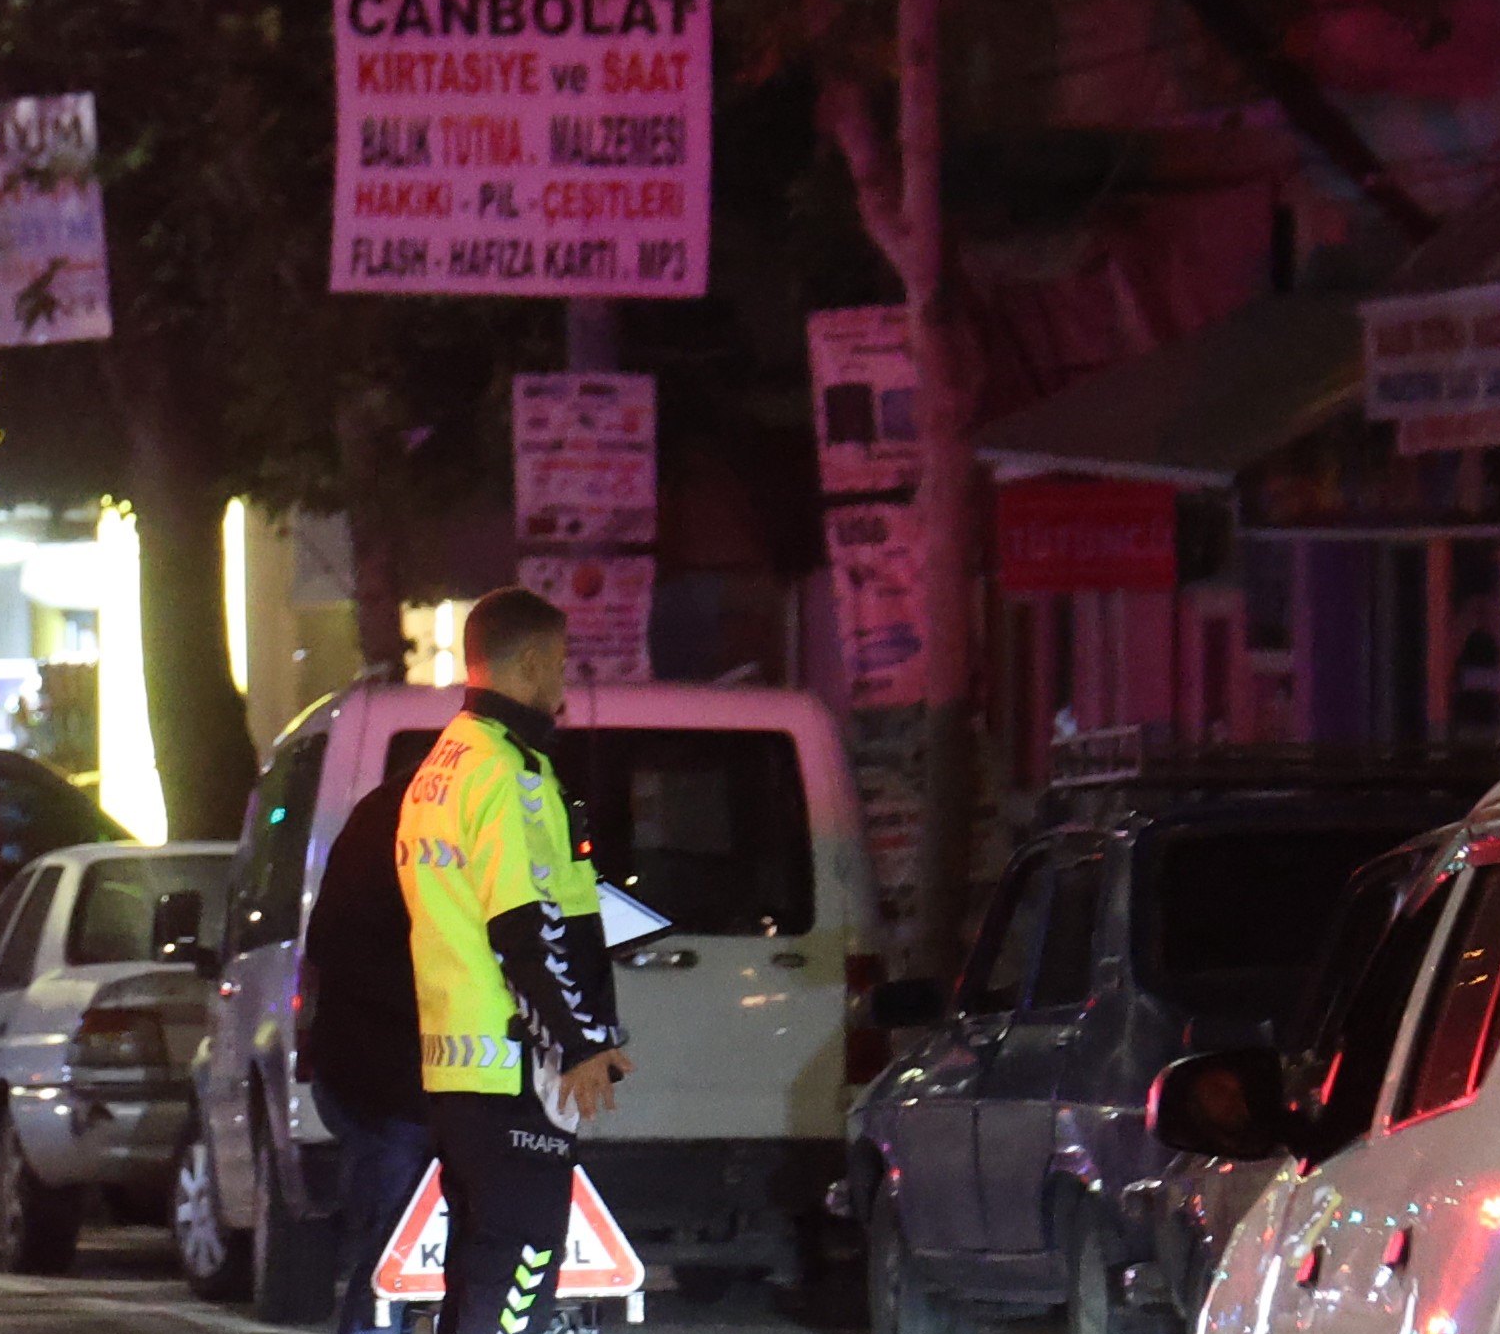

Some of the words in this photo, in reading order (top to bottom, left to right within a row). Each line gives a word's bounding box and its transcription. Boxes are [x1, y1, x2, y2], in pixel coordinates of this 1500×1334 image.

[551, 66, 588, 94] ve
[602, 51, 691, 94] SAAT
[360, 115, 431, 167] BALIK
[350, 236, 428, 278] FLASH
[637, 240, 688, 282] MP3
